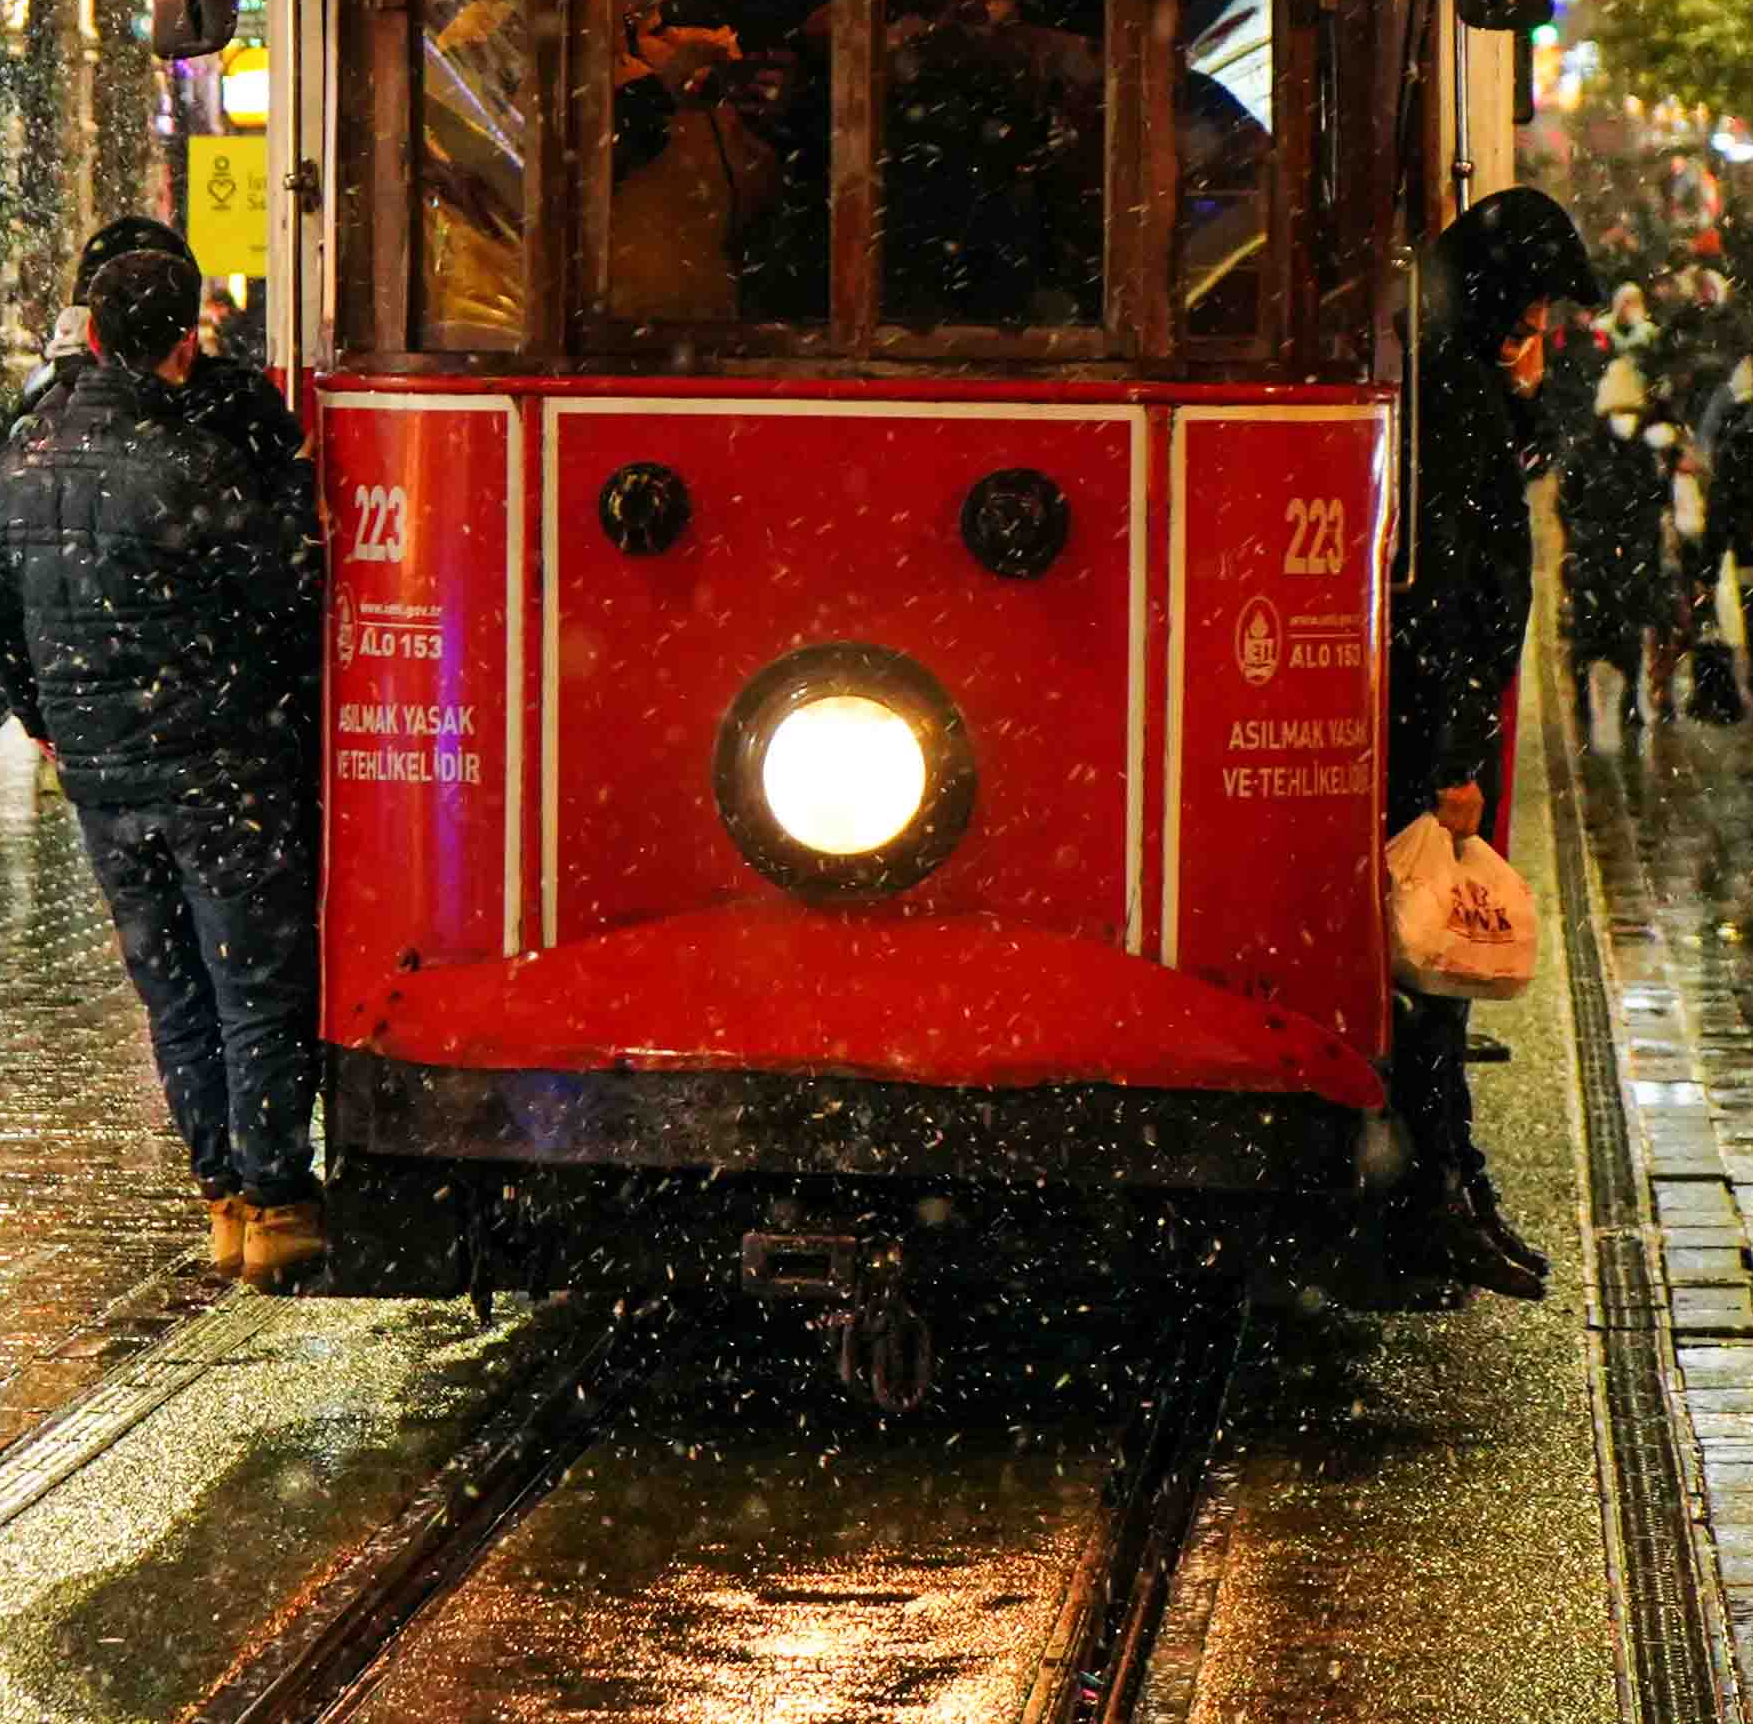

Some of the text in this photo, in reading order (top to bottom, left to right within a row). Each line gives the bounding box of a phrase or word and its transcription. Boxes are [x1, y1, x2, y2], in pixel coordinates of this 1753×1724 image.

[354, 485, 407, 563] 223
[1284, 498, 1344, 575] 223
[400, 633, 443, 659] 153
[1289, 643, 1330, 669] ALO
[339, 704, 475, 736] ASILMAK YASAK
[1227, 719, 1324, 751] ASILMAK
[350, 746, 481, 784] TEHLİKELİDİR
[1223, 767, 1254, 798] VE
